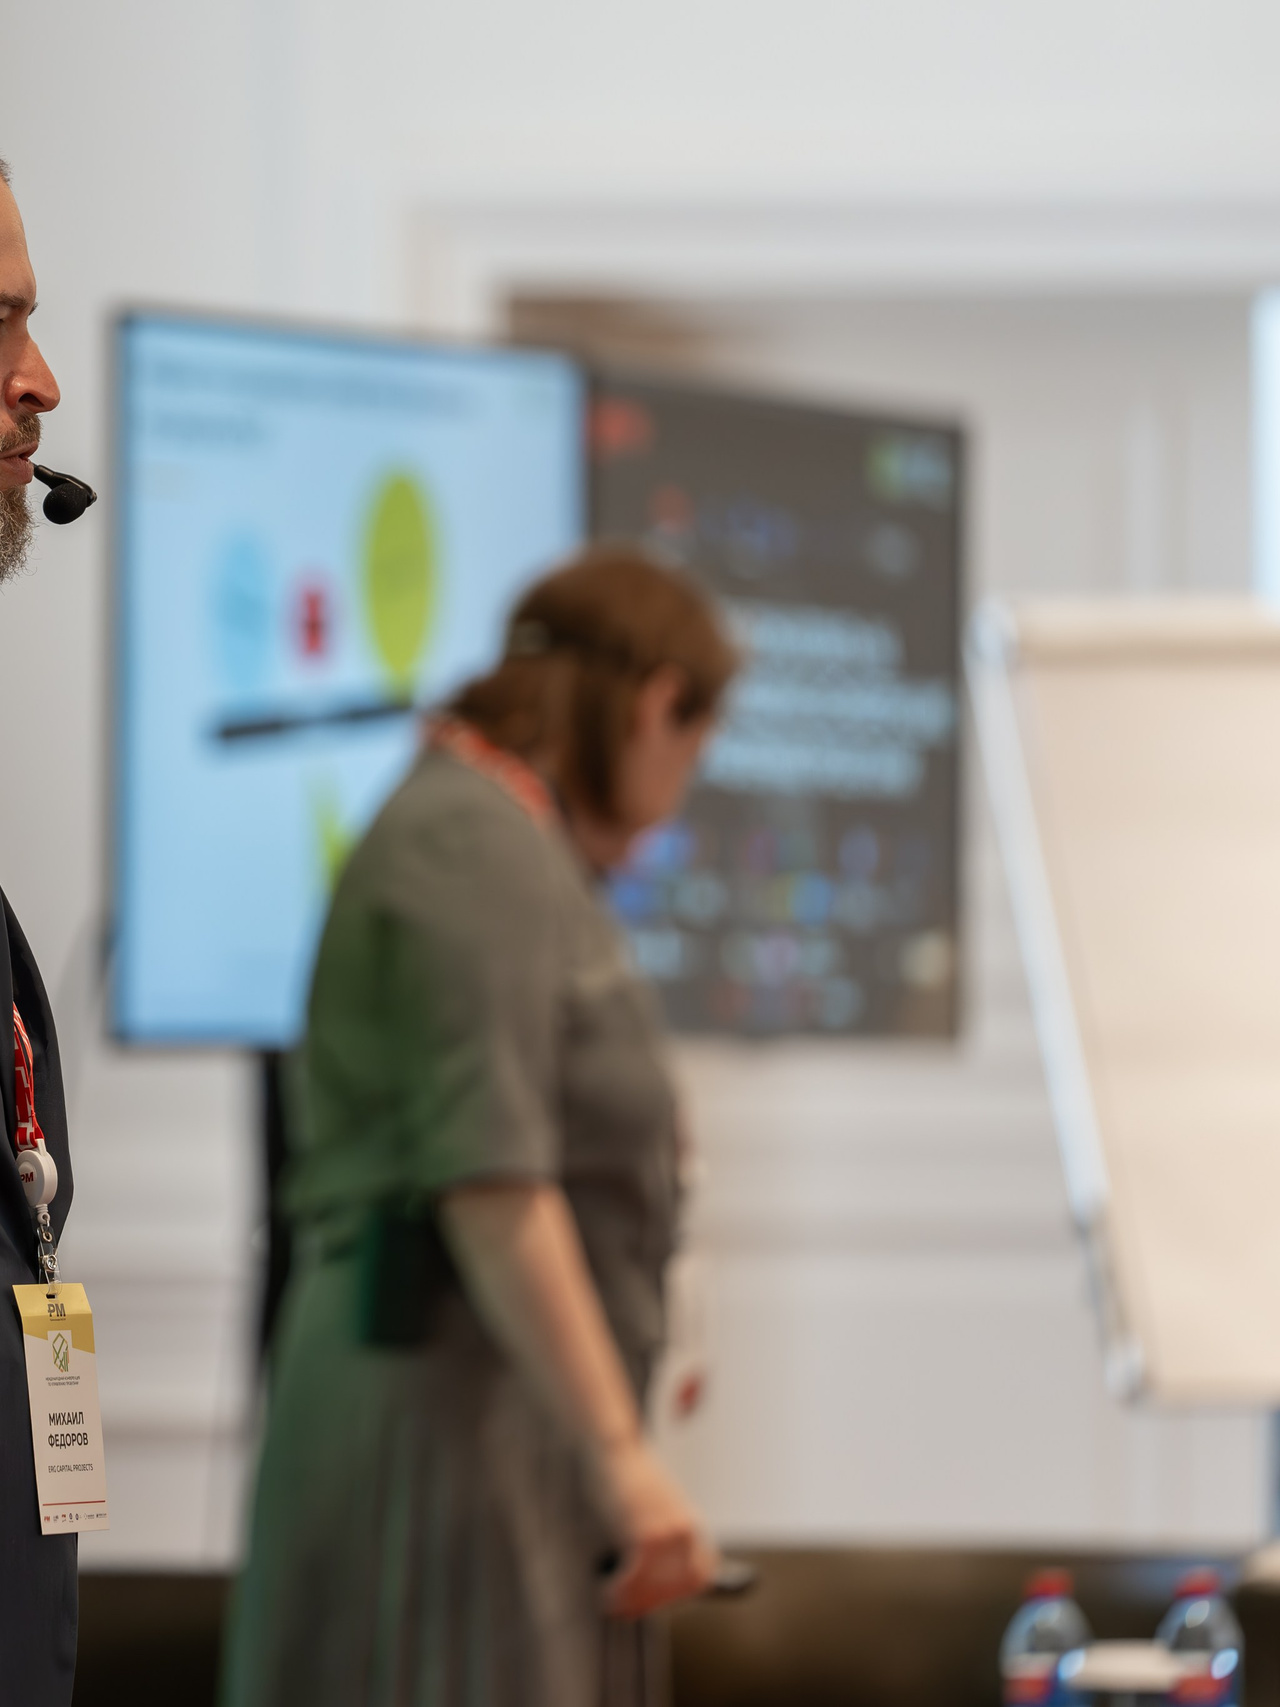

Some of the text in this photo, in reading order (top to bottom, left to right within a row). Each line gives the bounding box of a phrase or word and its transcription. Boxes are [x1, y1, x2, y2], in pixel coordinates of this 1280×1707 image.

[47, 1303, 66, 1317] PM
[48, 1412, 84, 1426] МИХАИЛ
[48, 1432, 89, 1449] ФЕДОРОВ
[57, 1464, 73, 1472] CAPITAL
[73, 1464, 93, 1472] PROJECTS
